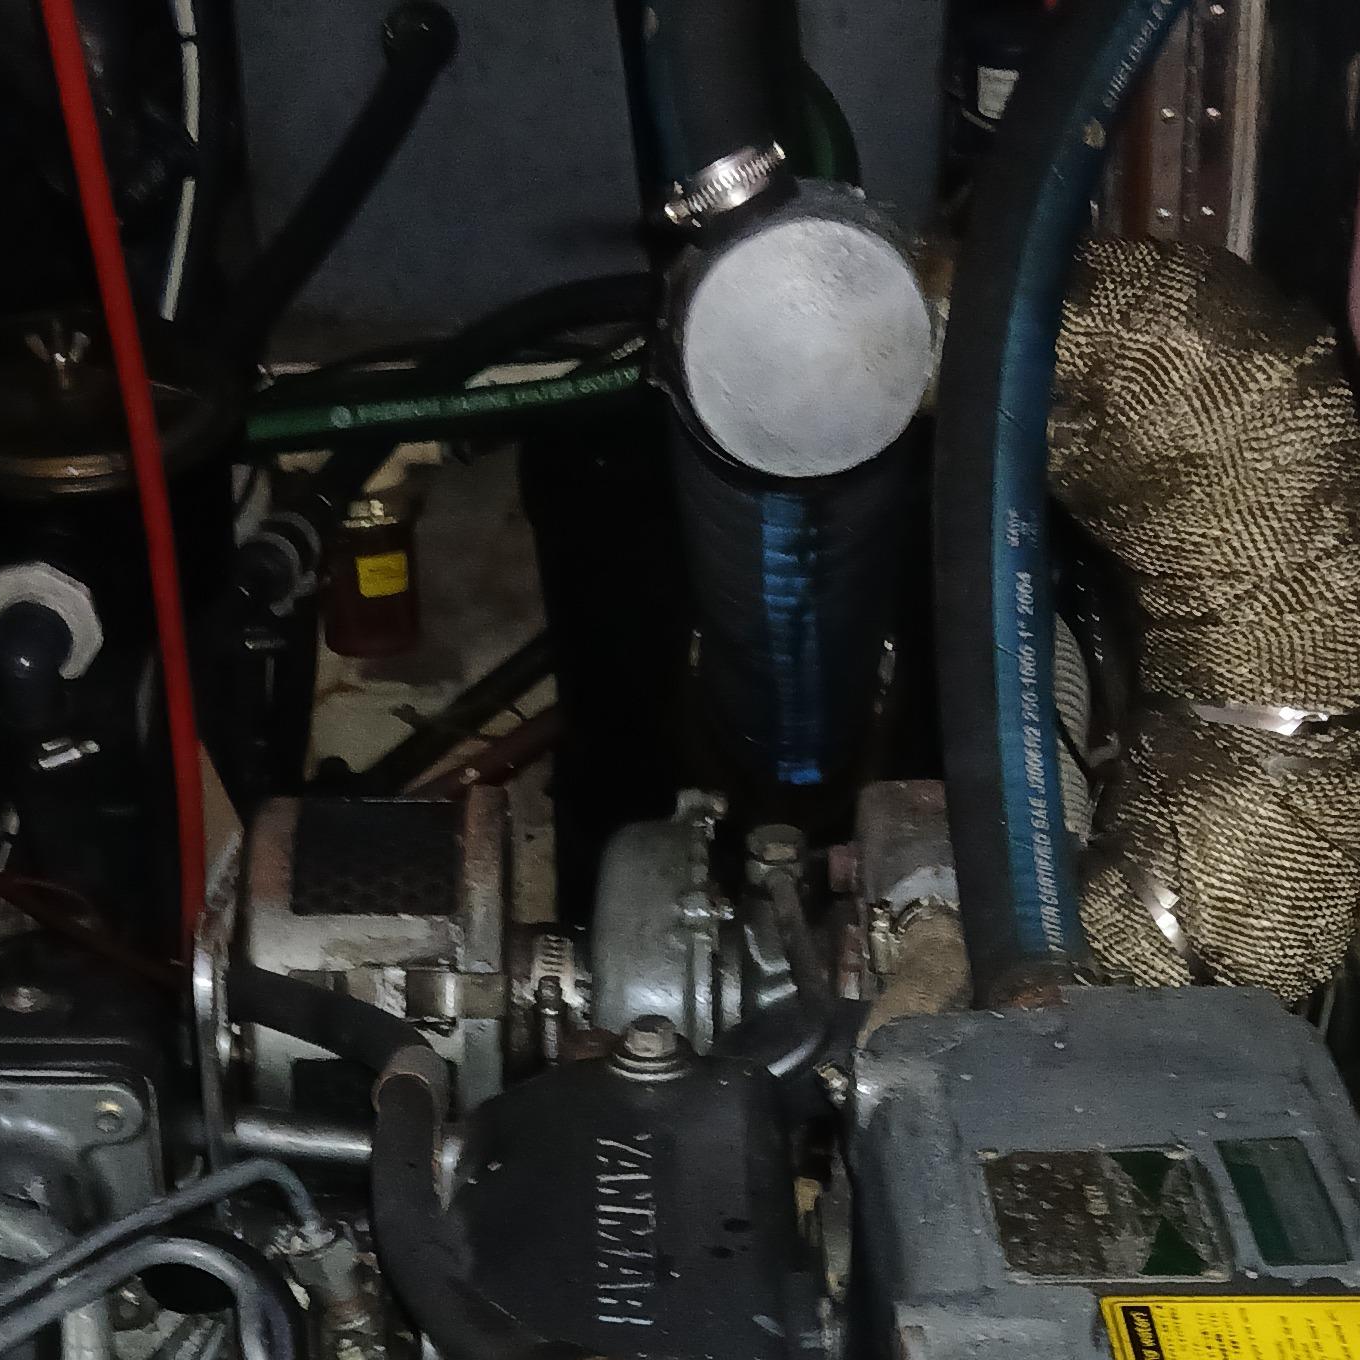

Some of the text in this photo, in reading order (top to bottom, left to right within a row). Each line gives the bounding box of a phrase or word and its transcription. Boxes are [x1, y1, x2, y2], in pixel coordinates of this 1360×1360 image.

[1016, 571, 1034, 616] 2004
[1024, 796, 1049, 831] SAE
[596, 1133, 656, 1326] YANMAR
